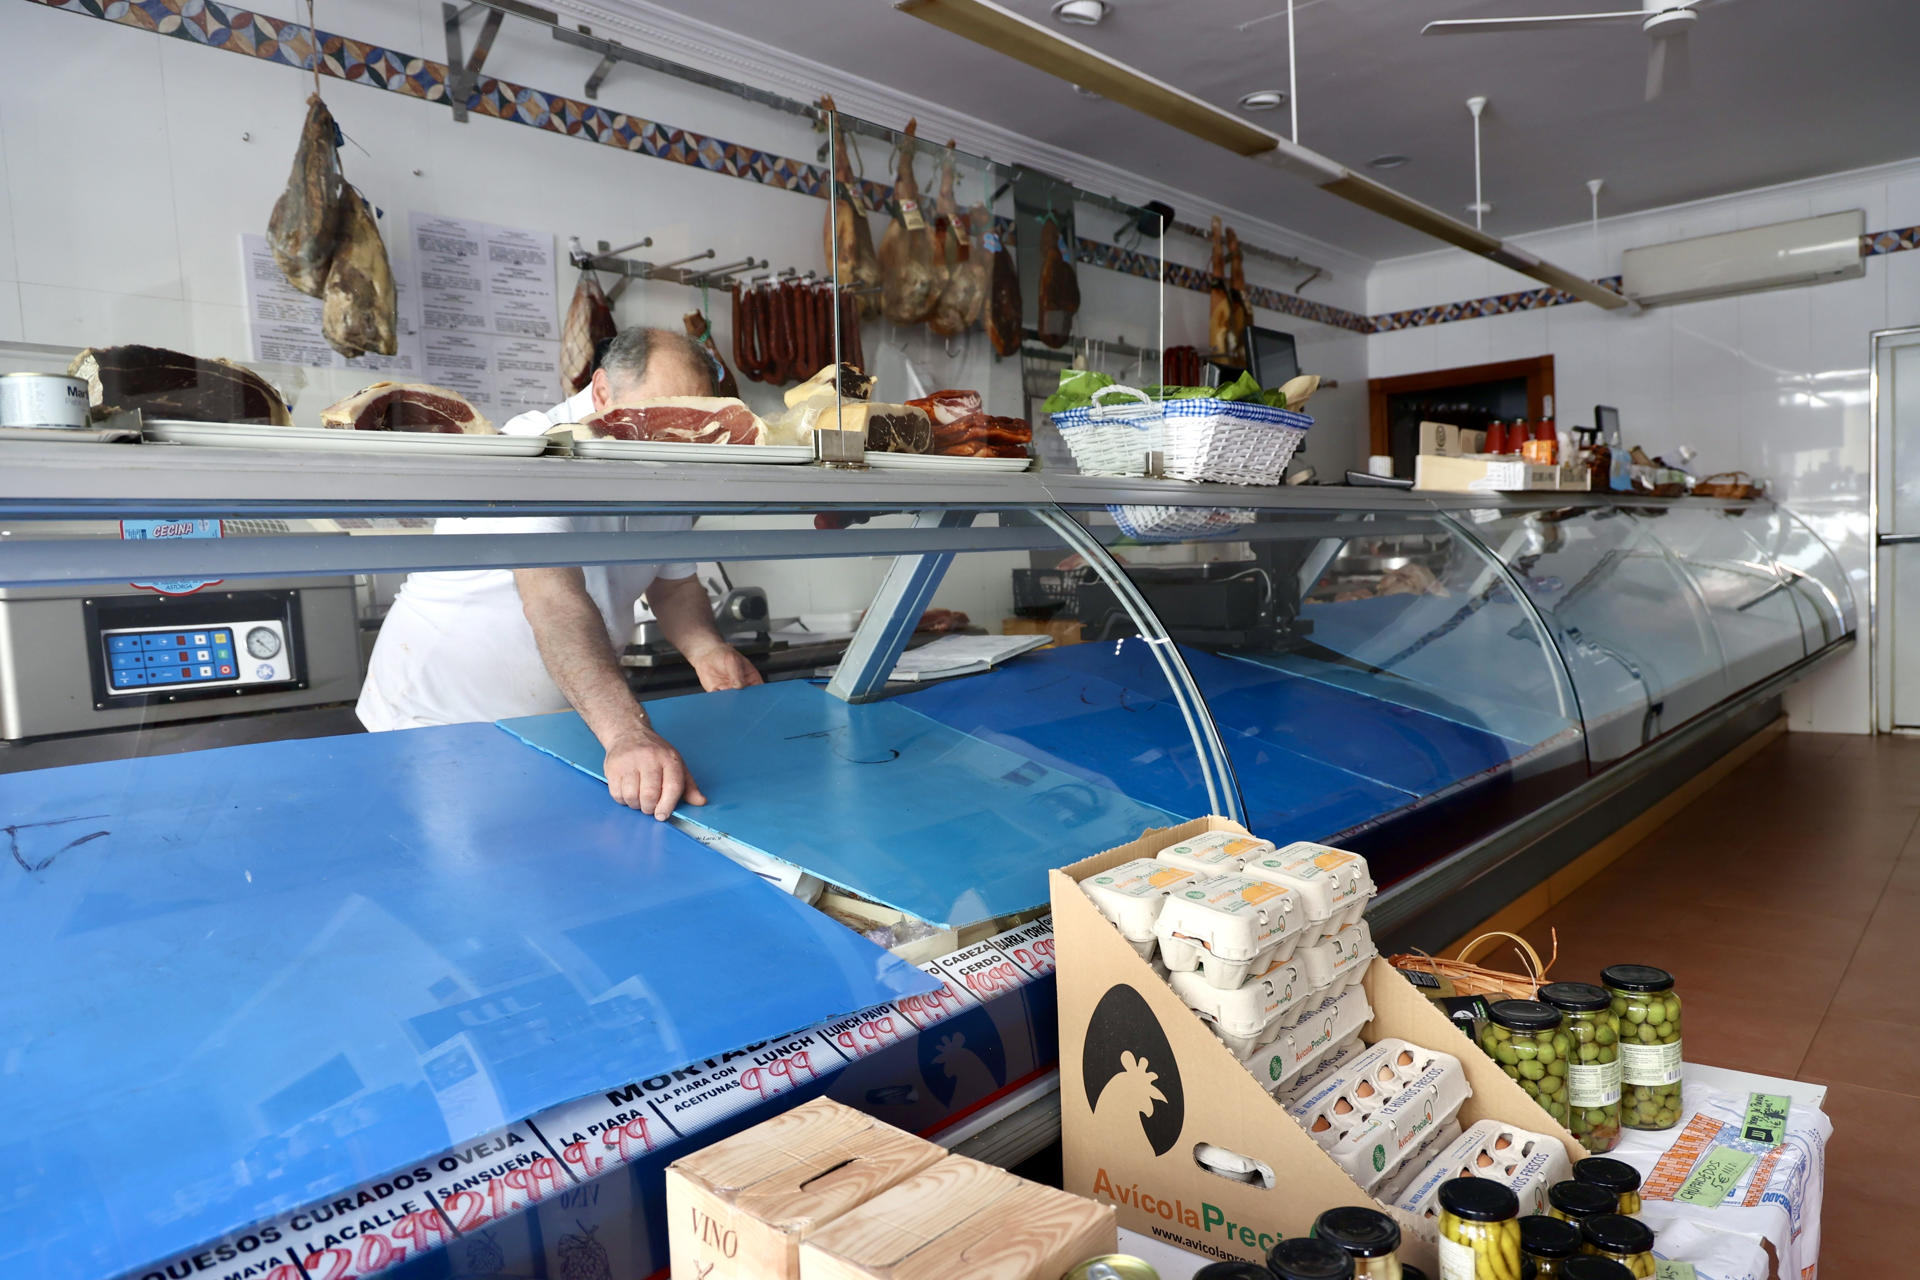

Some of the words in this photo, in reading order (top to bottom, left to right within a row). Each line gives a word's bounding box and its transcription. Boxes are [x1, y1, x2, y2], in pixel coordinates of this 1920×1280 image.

[152, 522, 194, 538] CECINA
[994, 932, 1028, 951] BARRA
[1025, 923, 1048, 941] YORK
[942, 943, 994, 967] CABEZA
[959, 955, 1002, 976] CERDO
[823, 1016, 862, 1037] LUNCH
[863, 1006, 890, 1021] PAVO
[753, 1036, 815, 1067] LUNCH
[654, 1090, 673, 1105] LA
[675, 1078, 710, 1098] PIARA
[711, 1066, 738, 1081] CON
[674, 1079, 741, 1113] ACEITUNAS
[1380, 1108, 1397, 1116] 12
[1389, 1088, 1418, 1108] HUEVOS
[1412, 1068, 1445, 1093] FRESCOS
[559, 1132, 587, 1148] LA
[587, 1108, 644, 1137] PIARA
[290, 1167, 433, 1231] CURADOS
[438, 1131, 525, 1172] OVEJA
[437, 1149, 545, 1199] SANSUEÑA
[1519, 1153, 1550, 1177] FRESCOS
[305, 1200, 420, 1256] LACALLE
[691, 1206, 739, 1259] VINO
